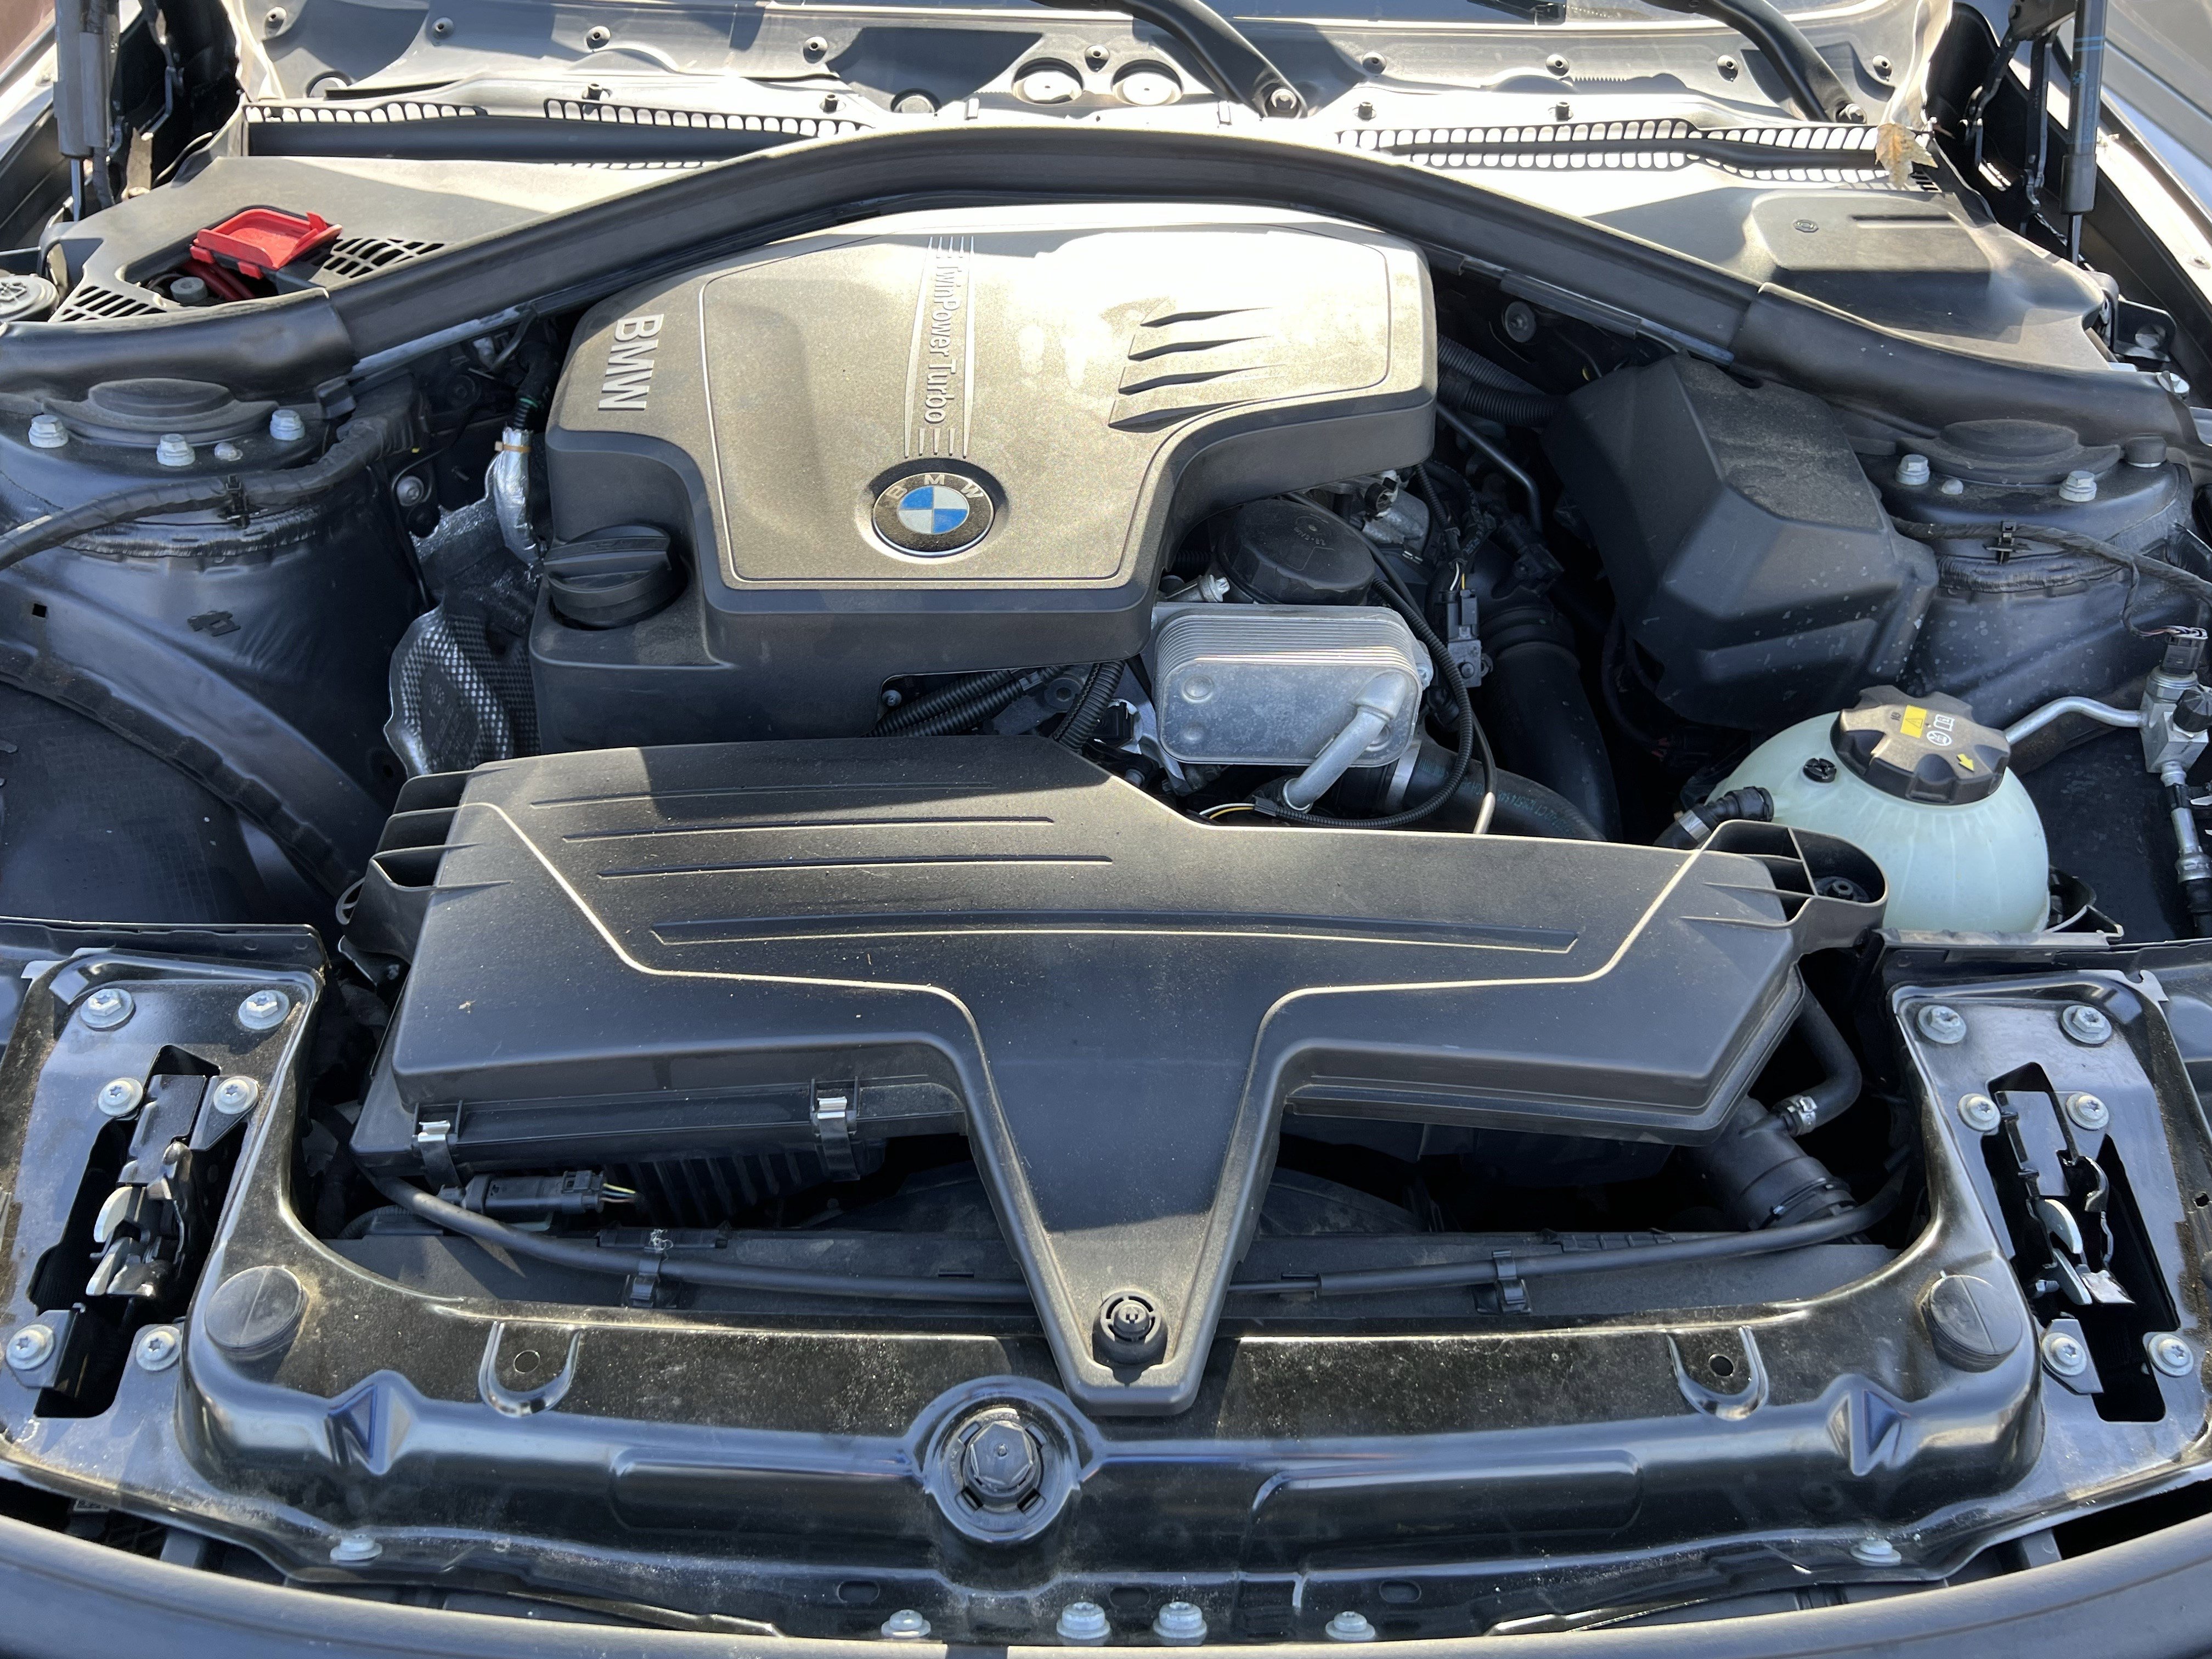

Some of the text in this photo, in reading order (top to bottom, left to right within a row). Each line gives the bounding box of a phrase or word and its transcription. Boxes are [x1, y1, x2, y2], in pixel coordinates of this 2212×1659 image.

[598, 313, 664, 411] BMW
[924, 261, 962, 424] TwinPower Turbo
[885, 473, 984, 499] BMW
